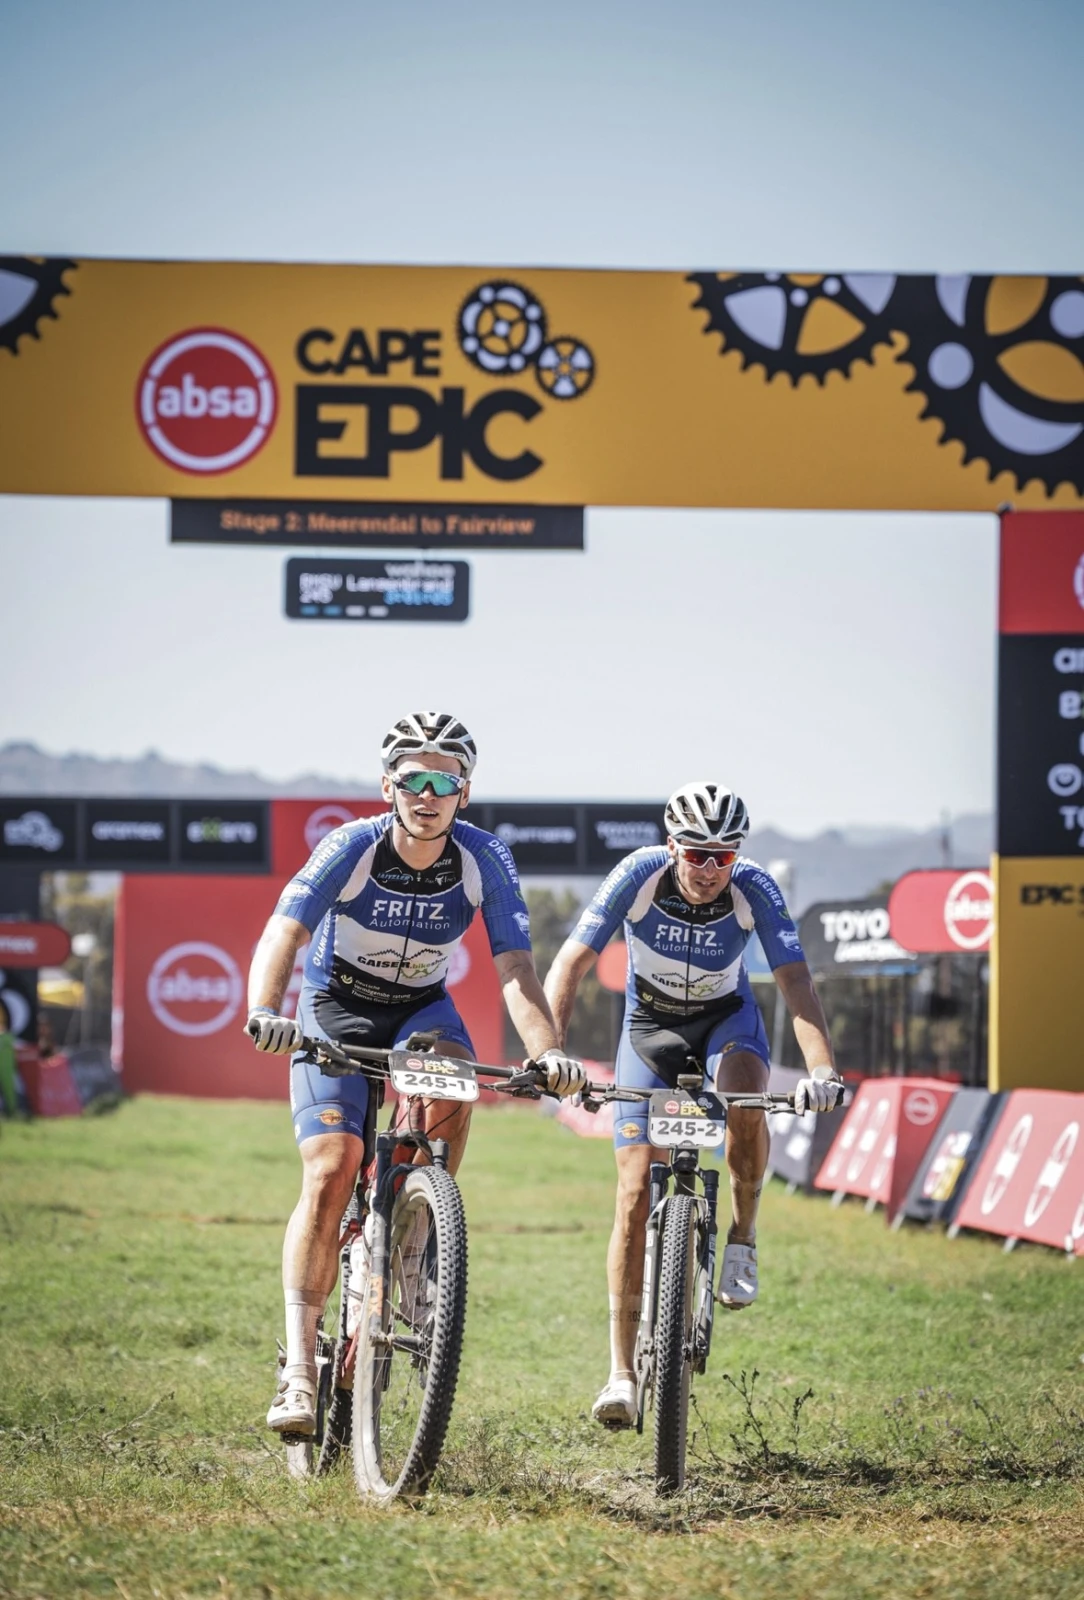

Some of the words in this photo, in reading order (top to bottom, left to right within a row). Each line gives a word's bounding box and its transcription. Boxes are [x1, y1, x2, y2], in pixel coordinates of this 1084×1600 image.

[295, 328, 442, 377] CAPE
[157, 374, 258, 418] absa
[294, 384, 545, 481] EPIC
[220, 509, 279, 534] Stage
[284, 511, 303, 532] 2:
[308, 511, 417, 537] Meerendal
[421, 516, 442, 535] to
[446, 516, 535, 536] Fairview
[303, 842, 341, 880] DREHER
[488, 839, 519, 884] DREHER
[751, 872, 783, 907] DREHER
[1021, 885, 1073, 906] EPIC
[372, 899, 444, 920] FRITZ
[369, 917, 450, 930] Automation
[655, 924, 717, 947] FRITZ
[820, 908, 890, 942] TOYO
[653, 941, 724, 956] Automation
[160, 967, 231, 1002] absa
[424, 1063, 456, 1075] EPIC
[404, 1073, 467, 1092] 245-1
[681, 1105, 708, 1116] EPIC
[657, 1119, 718, 1137] 245-2
